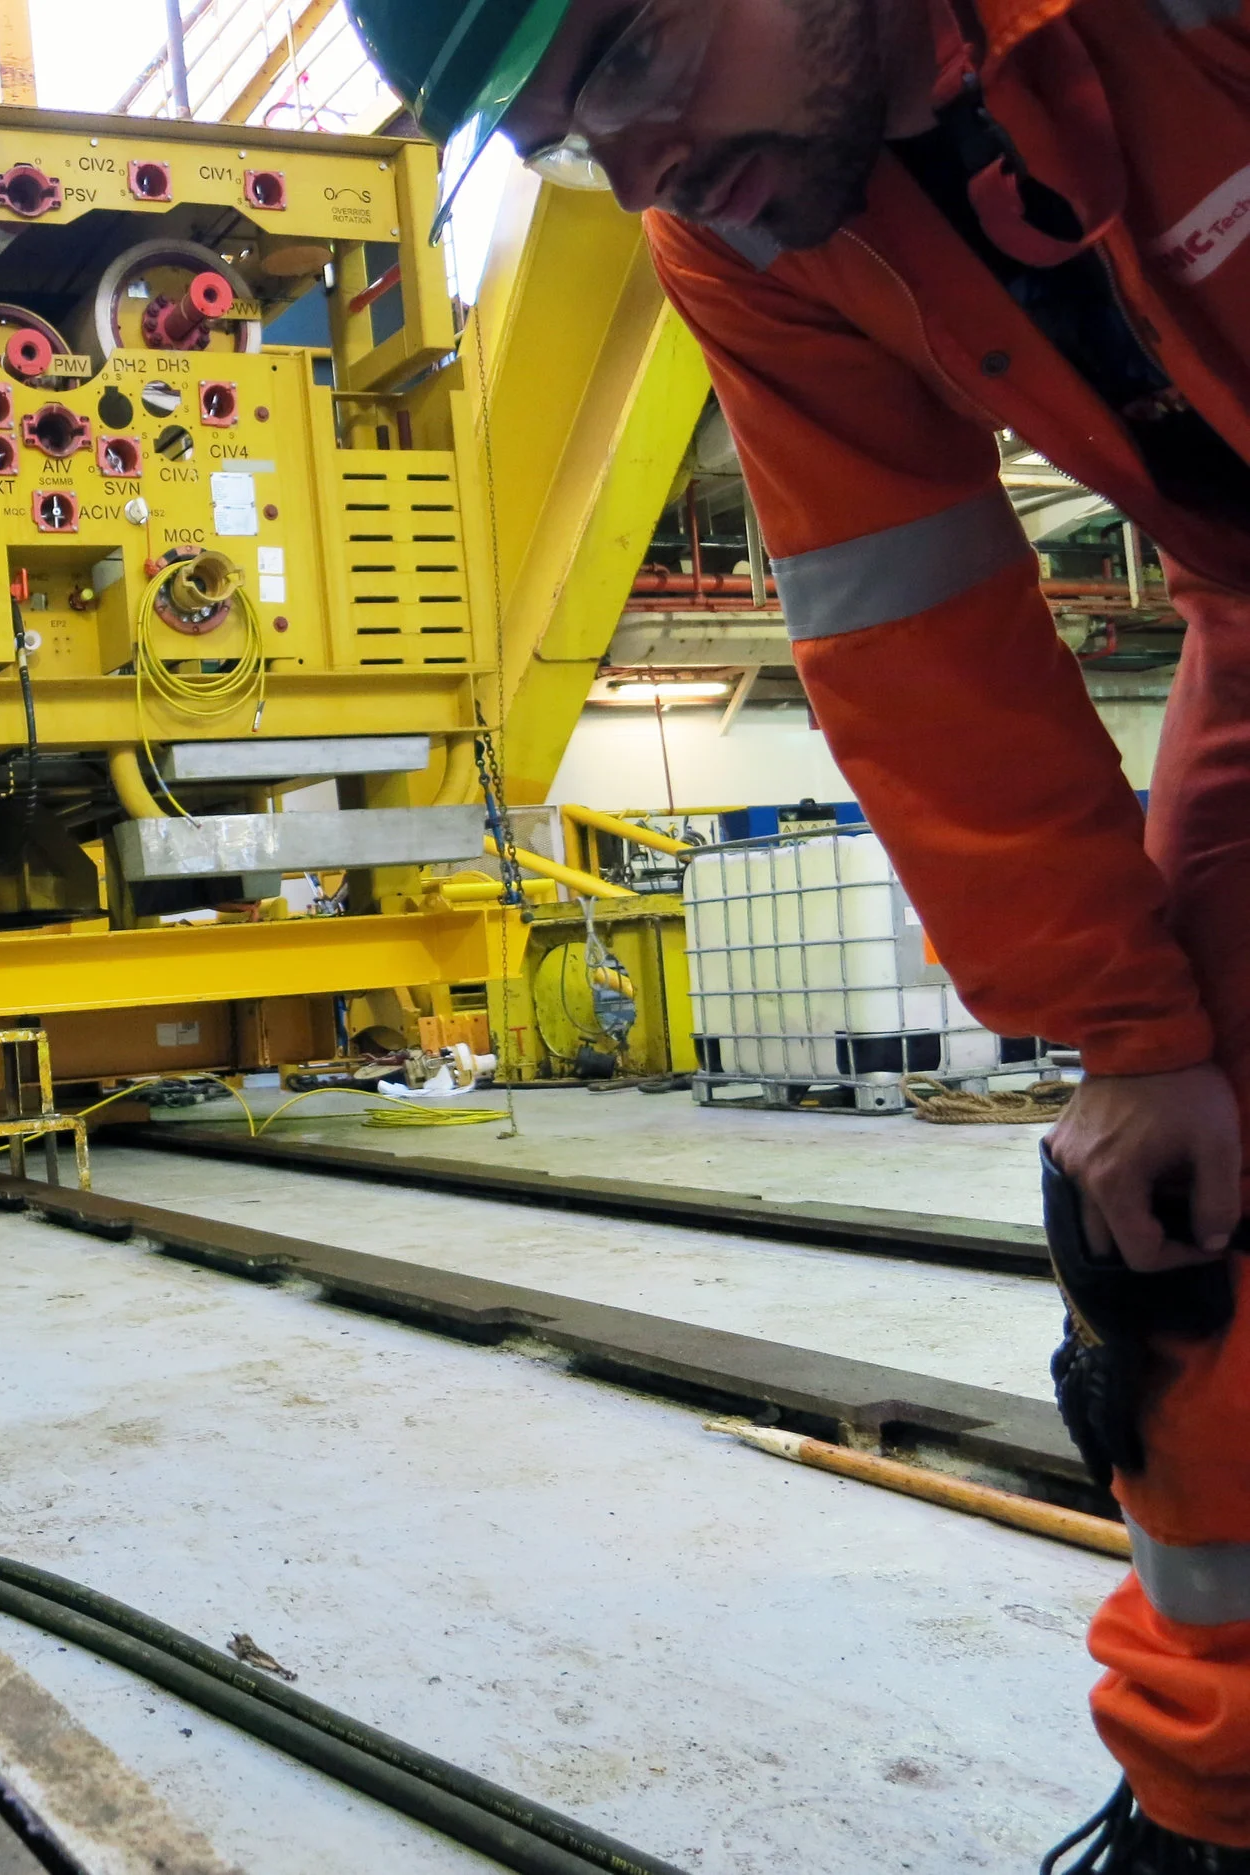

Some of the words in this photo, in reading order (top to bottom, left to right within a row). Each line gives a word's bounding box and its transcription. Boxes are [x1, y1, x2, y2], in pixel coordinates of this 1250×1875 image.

[78, 157, 115, 173] CIV2
[199, 165, 233, 181] CIV1
[64, 187, 97, 202] PSV
[324, 187, 335, 201] O
[362, 190, 372, 204] S
[331, 206, 370, 217] OVERRIDE
[332, 215, 371, 224] ROTATION
[54, 358, 88, 374] PMV
[113, 358, 147, 373] DH2
[157, 358, 190, 374] DH3
[209, 444, 249, 459] CIV4
[42, 459, 72, 474] AIV
[39, 477, 74, 486] SCMMB
[159, 467, 199, 482] CIV3
[104, 481, 141, 496] SVN
[4, 507, 26, 517] MQC
[78, 505, 121, 520] ACIV
[164, 528, 205, 543] MQC
